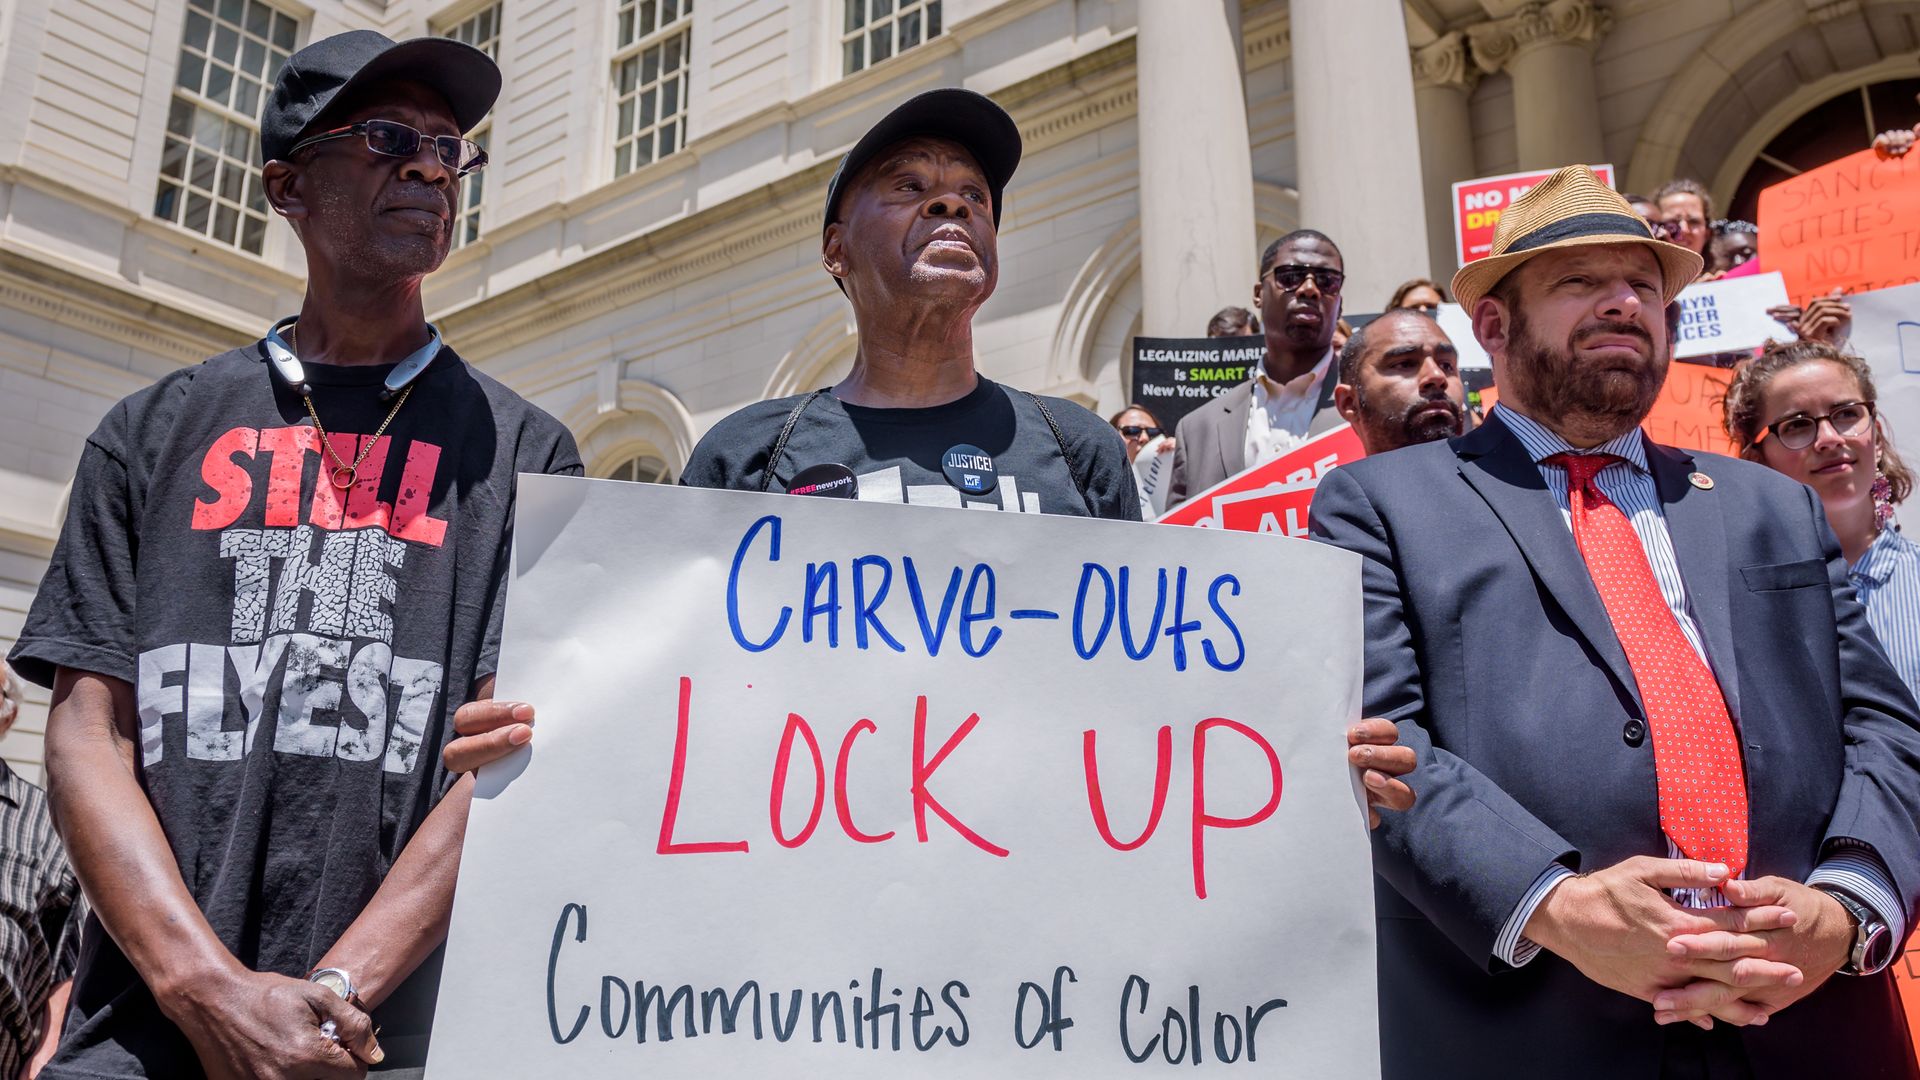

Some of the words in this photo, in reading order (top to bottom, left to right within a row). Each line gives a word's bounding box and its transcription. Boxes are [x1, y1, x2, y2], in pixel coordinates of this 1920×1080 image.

[1465, 189, 1503, 210] NO
[1784, 157, 1920, 212] SANC
[1466, 209, 1501, 230] DR
[1779, 201, 1895, 248] CITIES
[1806, 238, 1873, 281] NOT
[1680, 309, 1720, 325] DER
[1684, 323, 1722, 340] CES
[1139, 349, 1219, 362] LEGALIZING
[1142, 383, 1175, 397] New
[1176, 385, 1209, 398] York
[1211, 385, 1233, 398] Co
[1174, 368, 1187, 381] is
[1190, 367, 1246, 381] SMART
[948, 453, 992, 471] JUSTICE!
[191, 425, 447, 547] STILL
[1257, 504, 1308, 537] AL
[220, 525, 406, 644] THE
[138, 633, 443, 774] FLYEST
[657, 677, 1009, 857] LOCK
[547, 903, 970, 1052] Communities
[1120, 975, 1288, 1066] Color
